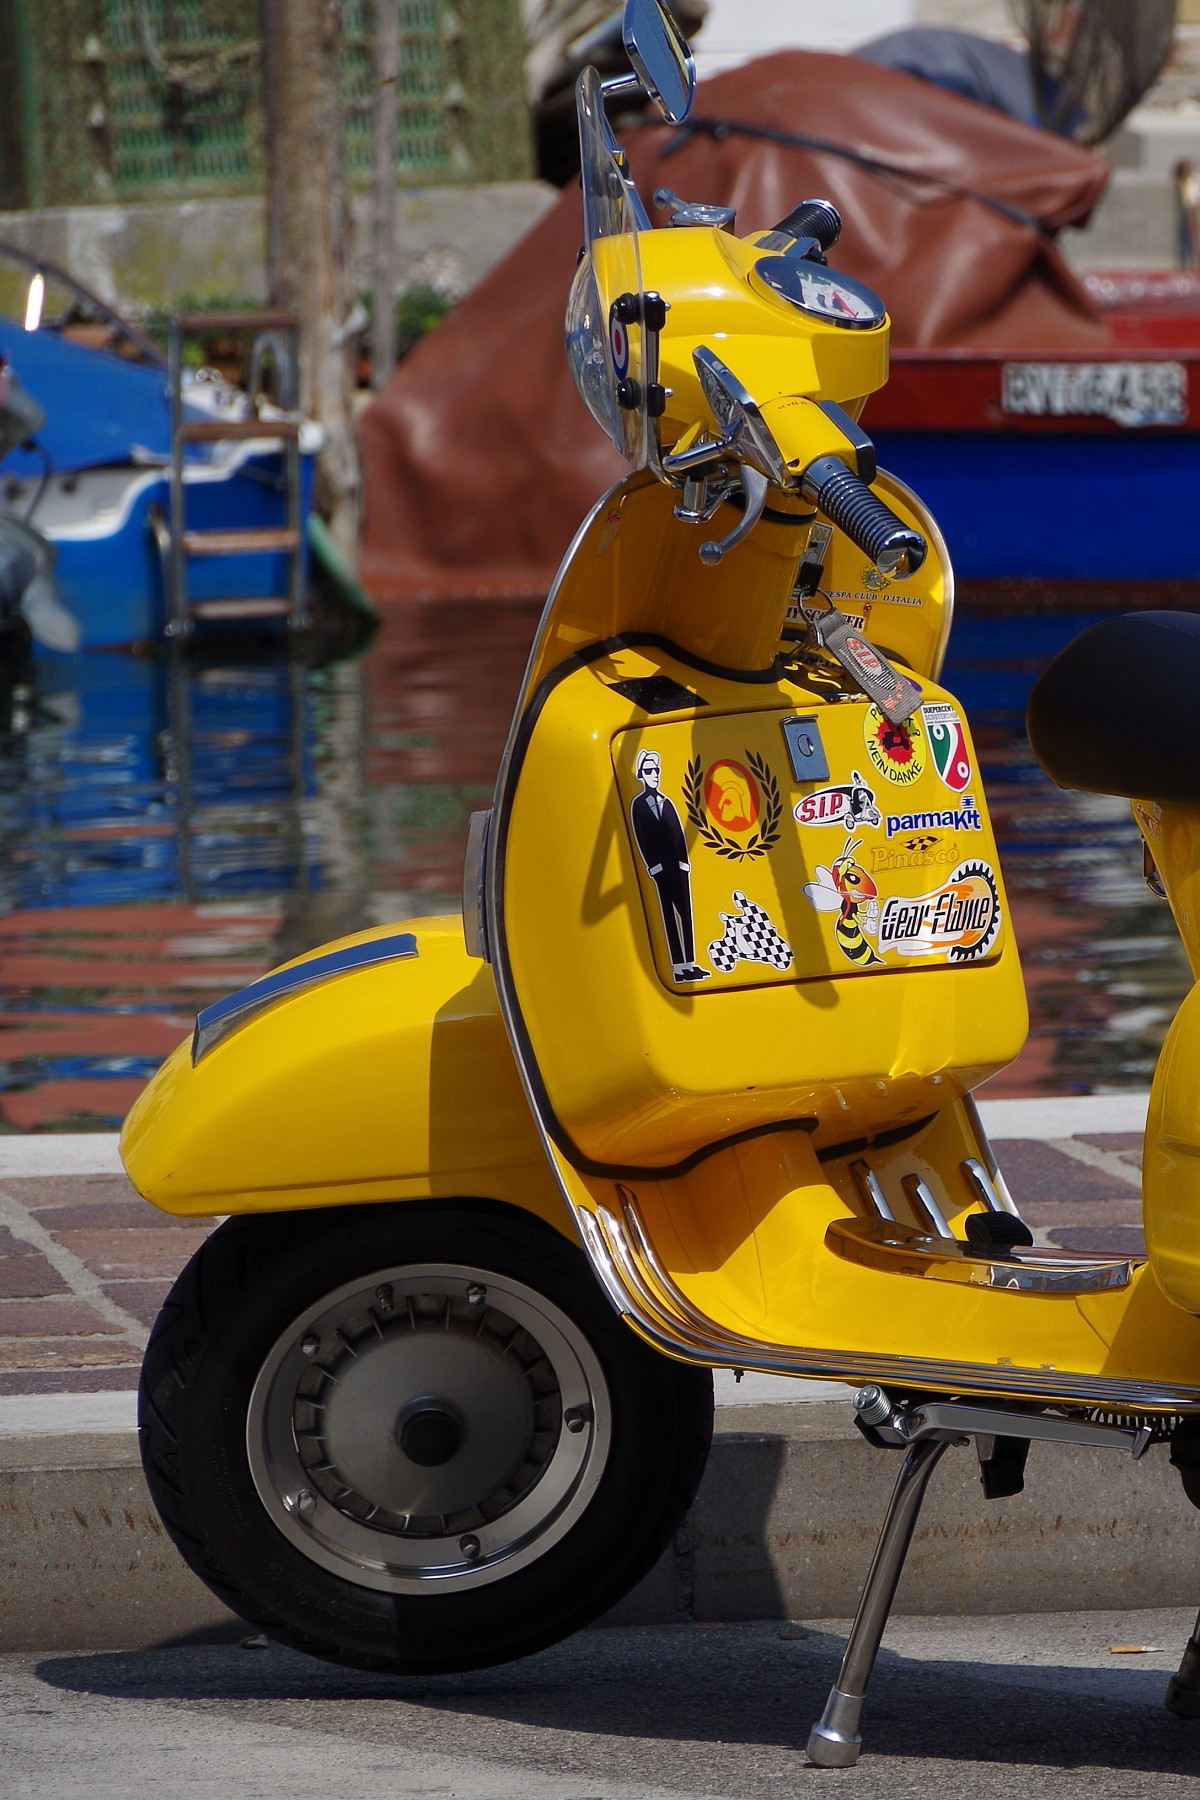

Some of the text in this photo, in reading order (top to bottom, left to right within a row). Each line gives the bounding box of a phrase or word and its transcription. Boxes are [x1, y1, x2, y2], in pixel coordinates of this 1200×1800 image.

[854, 591, 878, 600] CLUB
[867, 740, 923, 783] NEIN DANKE
[872, 846, 959, 873] Pinasco
[882, 893, 990, 940] Gear Flame
